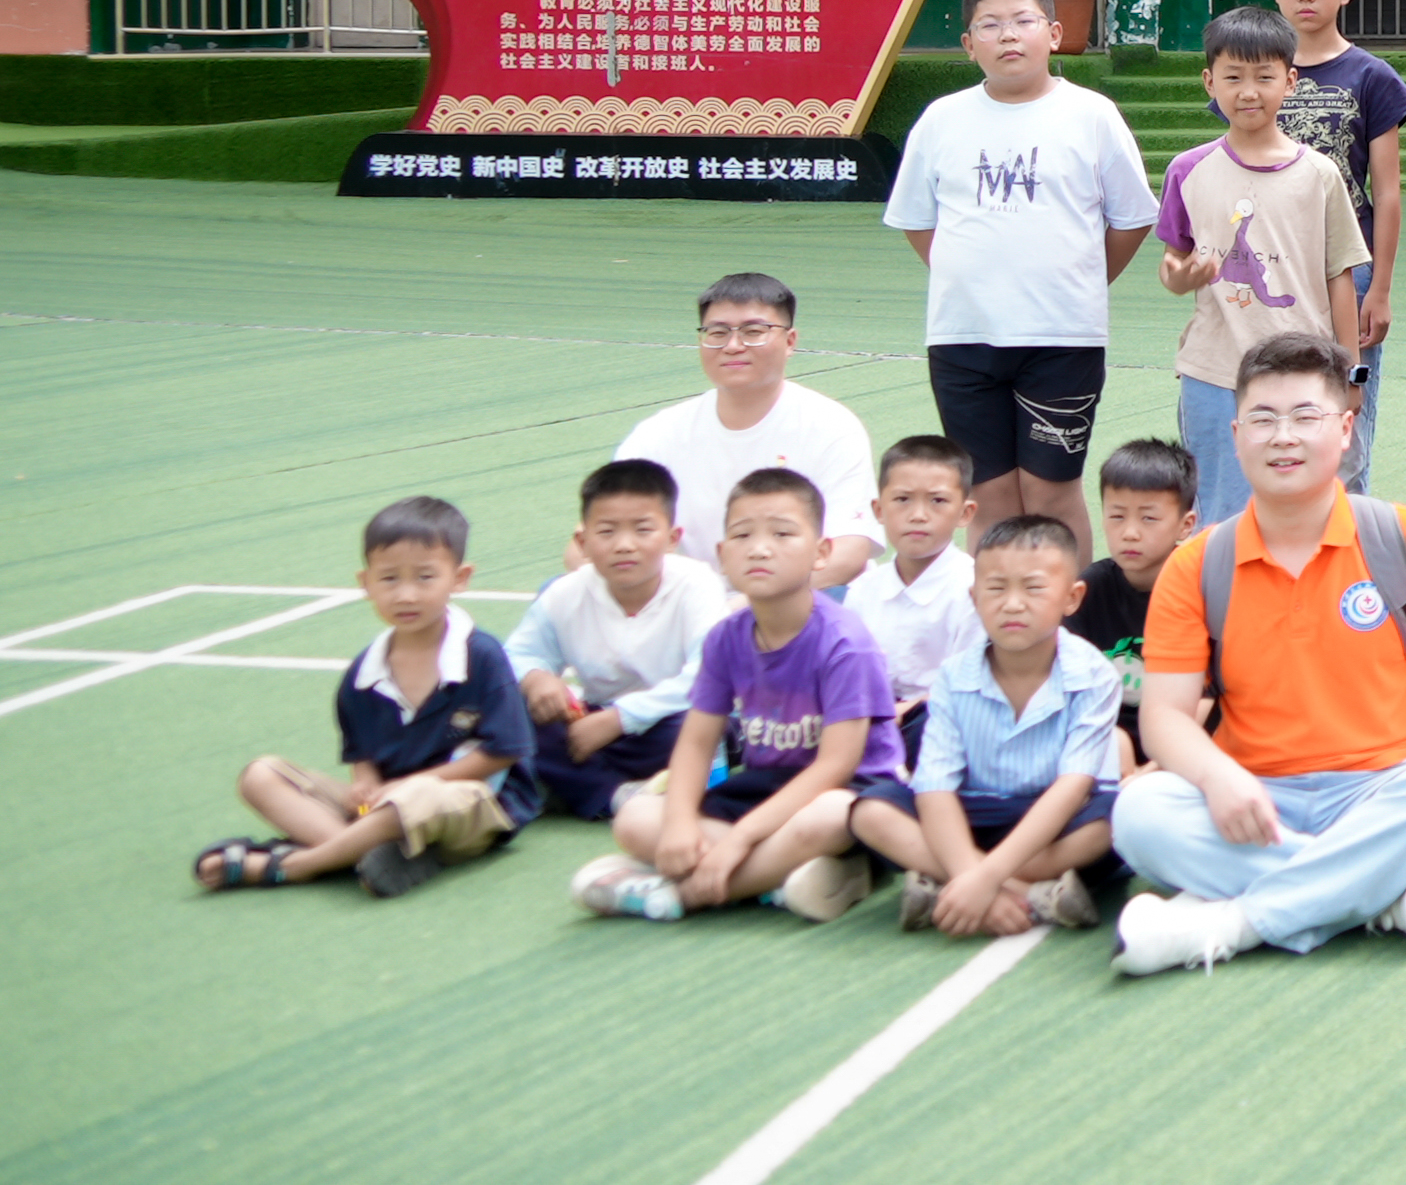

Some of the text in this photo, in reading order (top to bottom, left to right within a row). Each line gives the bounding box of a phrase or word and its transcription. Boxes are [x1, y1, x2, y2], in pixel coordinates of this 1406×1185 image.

[370, 154, 858, 181] 学好党史 新中国史 改革开放史 社会主义发展史
